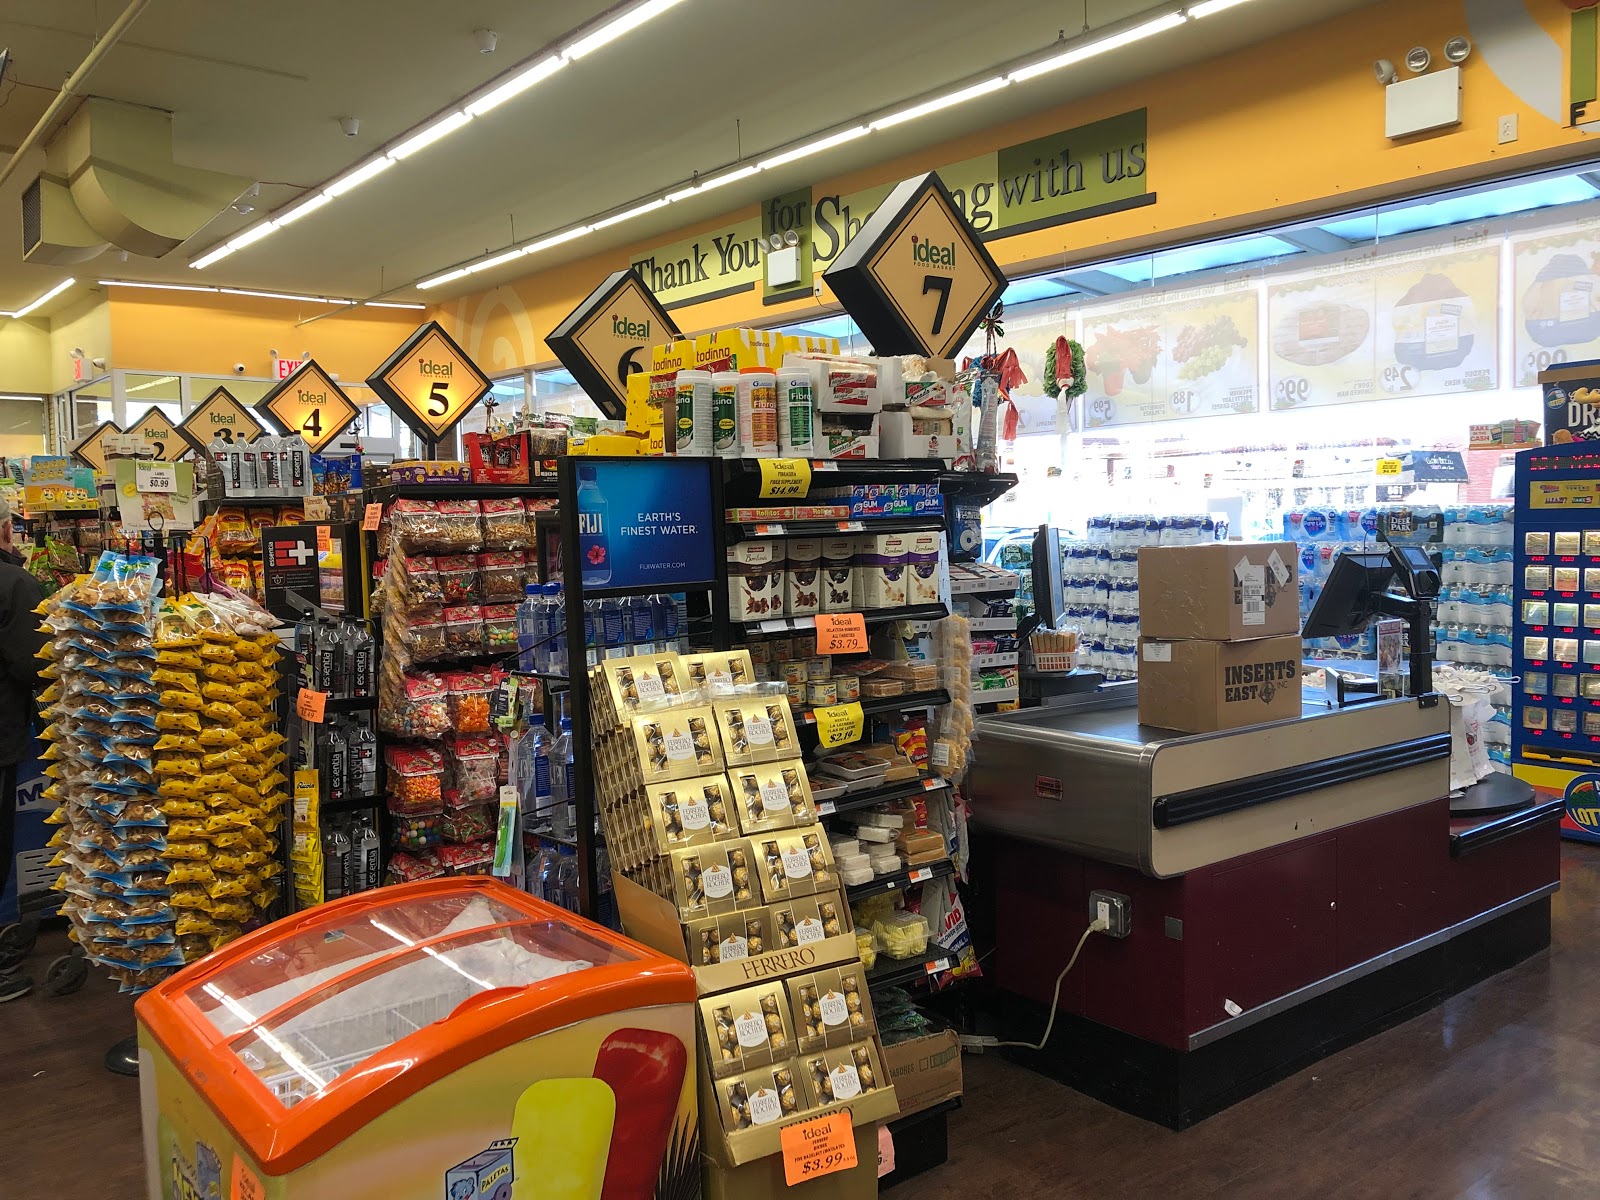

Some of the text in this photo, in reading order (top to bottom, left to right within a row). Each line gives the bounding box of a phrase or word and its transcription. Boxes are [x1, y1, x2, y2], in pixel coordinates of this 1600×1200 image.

[631, 243, 710, 294] Thank
[713, 233, 761, 277] You
[768, 196, 806, 235] for
[998, 148, 1086, 208] with
[1101, 142, 1146, 184] us
[912, 236, 956, 268] ideal
[922, 275, 953, 335] 7
[612, 314, 650, 338] ideal
[419, 358, 453, 377] ideal
[617, 346, 645, 388] 6
[298, 389, 327, 404] ideal
[428, 382, 449, 417] 5
[209, 411, 236, 424] ideal
[302, 408, 323, 437] 4
[144, 427, 169, 439] ideal
[152, 441, 167, 461] 2
[150, 479, 169, 488] $0.99
[769, 486, 800, 495] $14.99
[863, 500, 878, 508] GUM
[578, 513, 604, 534] FIJI
[637, 512, 681, 522] EARTH'S
[1391, 516, 1410, 525] DEER
[621, 526, 657, 536] FINEST
[1390, 522, 1411, 532] PARK
[639, 561, 686, 570] FIJIWATER.COM
[831, 618, 852, 626] ideal
[829, 639, 858, 650] $3.79
[322, 652, 331, 687] essentia
[356, 651, 365, 686] esentia
[1225, 660, 1296, 686] INSERTS
[1225, 685, 1259, 703] EAST
[829, 730, 854, 743] $2.19
[742, 947, 816, 980] FERRERO
[802, 1122, 832, 1140] ideal
[802, 1152, 843, 1174] $3.99
[481, 1165, 509, 1191] PALETAS
